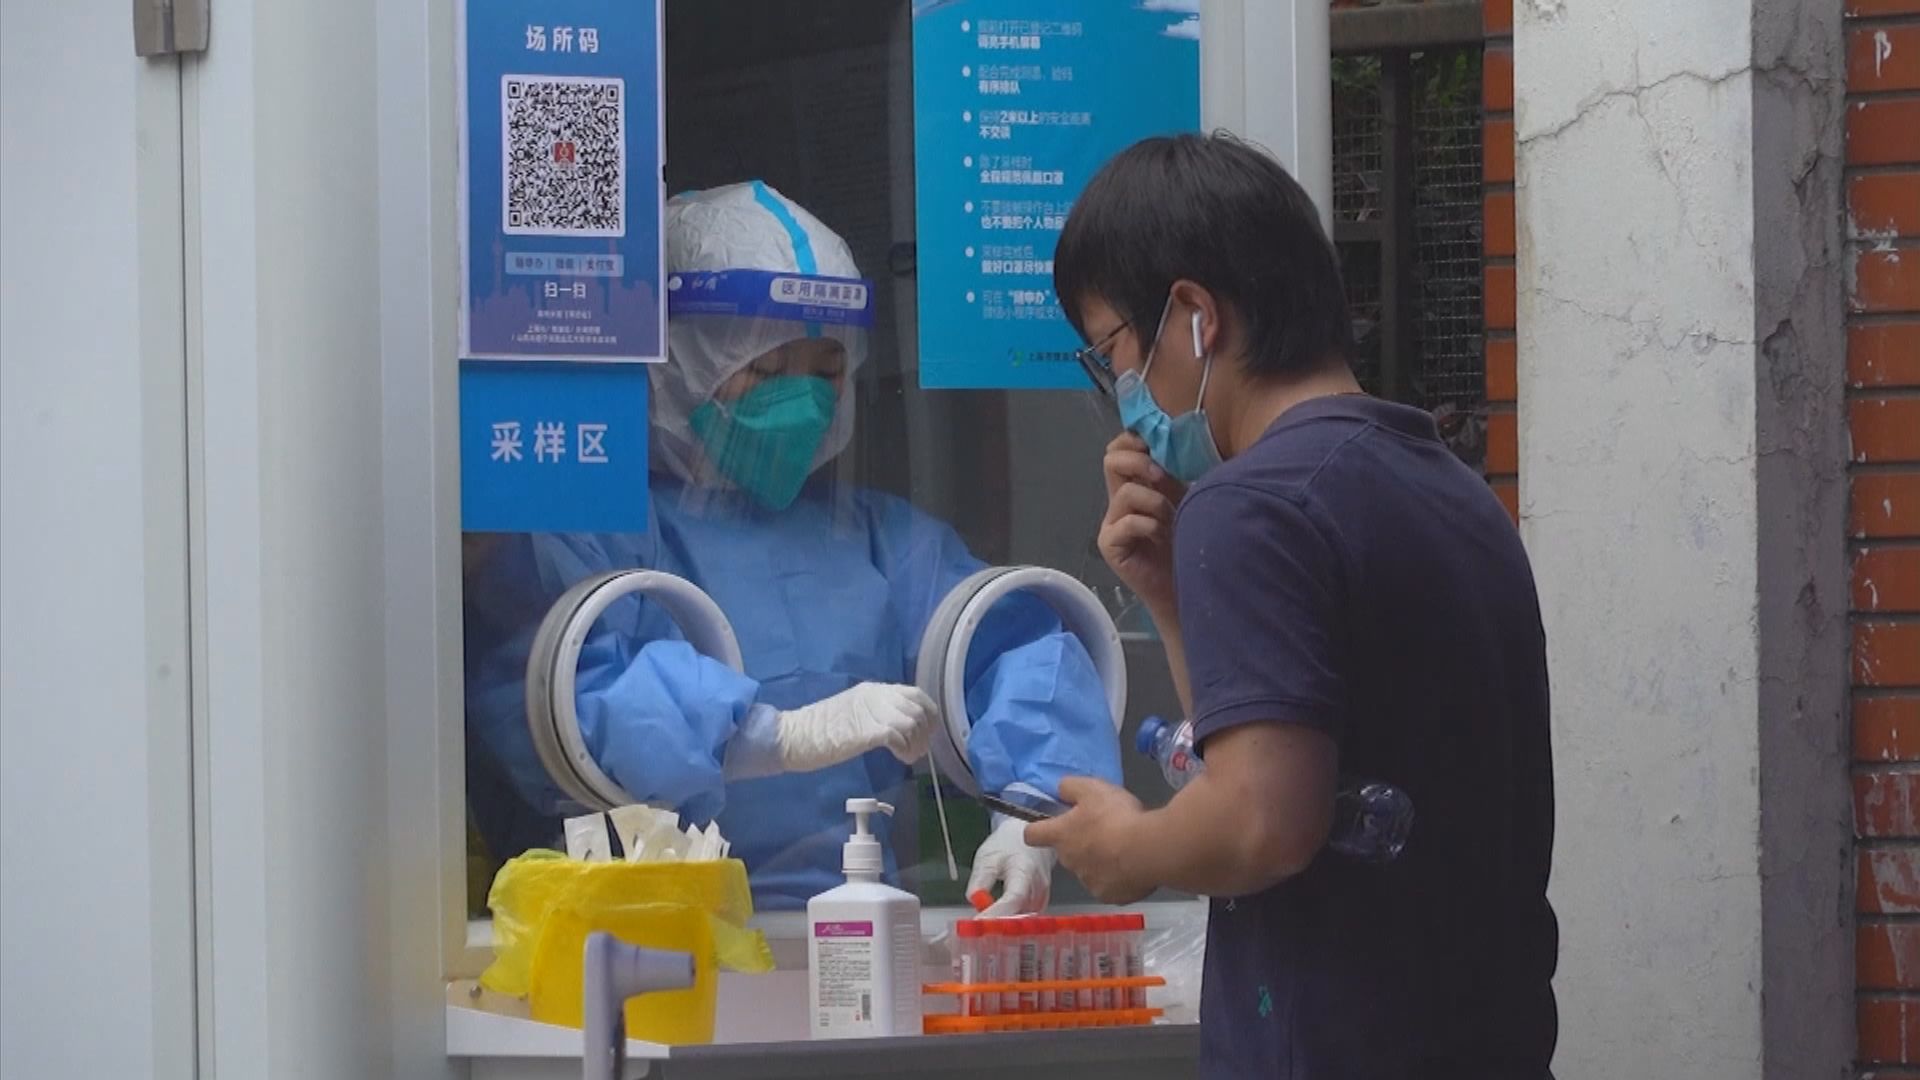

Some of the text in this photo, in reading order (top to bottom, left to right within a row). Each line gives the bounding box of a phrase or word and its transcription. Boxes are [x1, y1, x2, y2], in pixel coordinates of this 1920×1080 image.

[525, 24, 600, 54] 场所码
[978, 81, 1020, 94] 有序排队
[979, 125, 1010, 138] 不交谈
[980, 170, 1064, 184] 全程规范佩戴口罩
[586, 258, 614, 271] 支付宝
[544, 280, 586, 299] 扫一扫
[781, 279, 863, 302] 医用隔离面罩
[490, 420, 609, 464] 采样区
